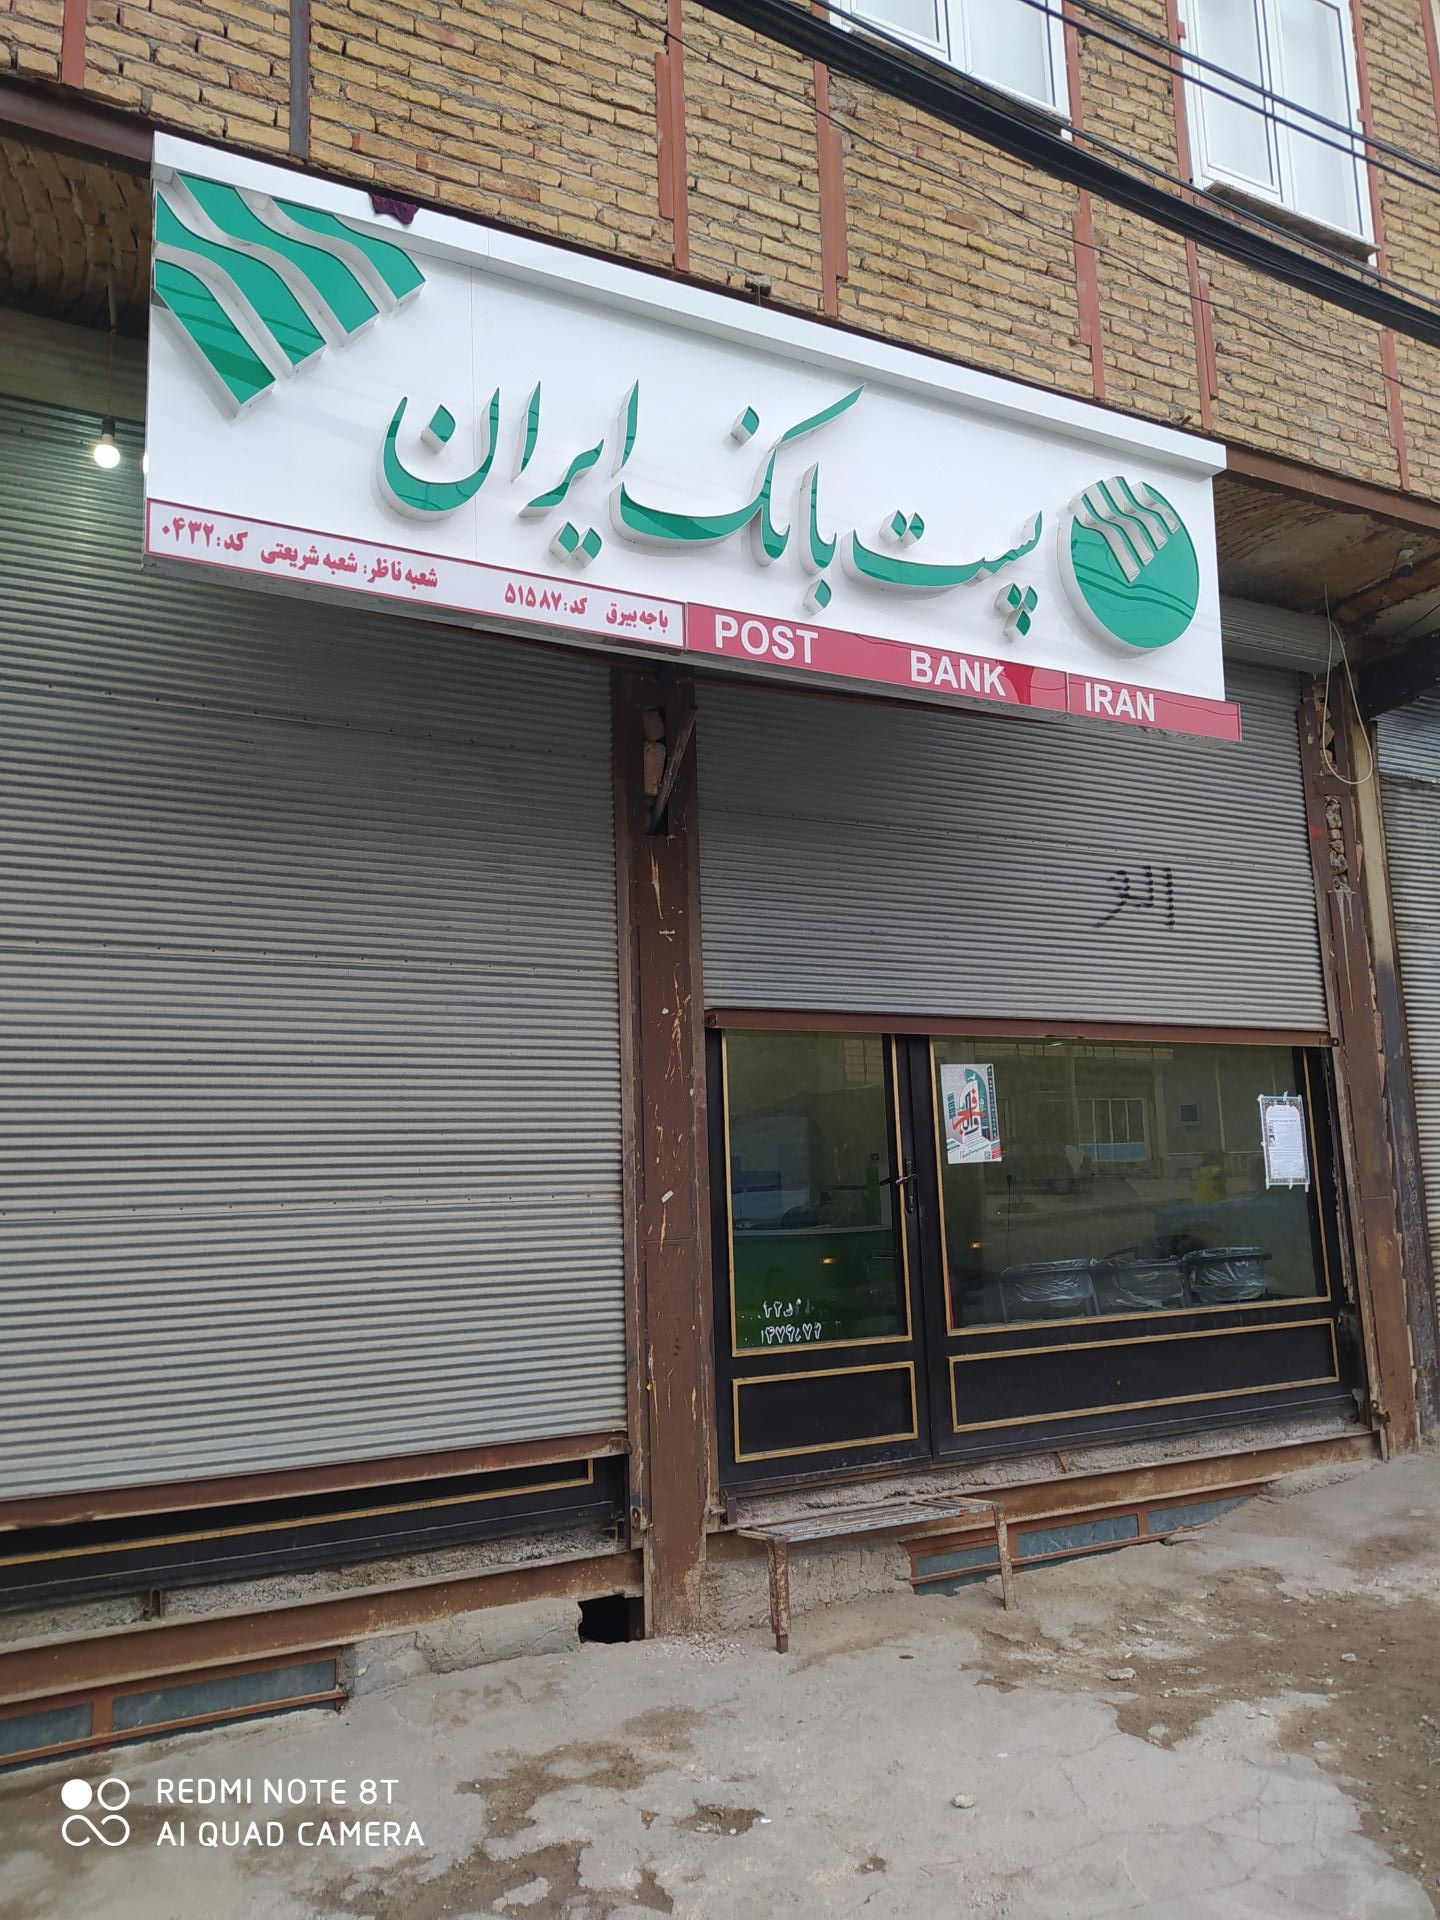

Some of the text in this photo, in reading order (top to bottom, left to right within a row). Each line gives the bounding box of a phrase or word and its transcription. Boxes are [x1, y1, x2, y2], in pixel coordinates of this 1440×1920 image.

[379, 380, 1043, 639] پست بانک ایران
[260, 543, 319, 571] شریعتی
[322, 552, 358, 575] شعبه
[404, 568, 438, 590] شعبه
[714, 613, 1156, 722] POST BANK IRAN
